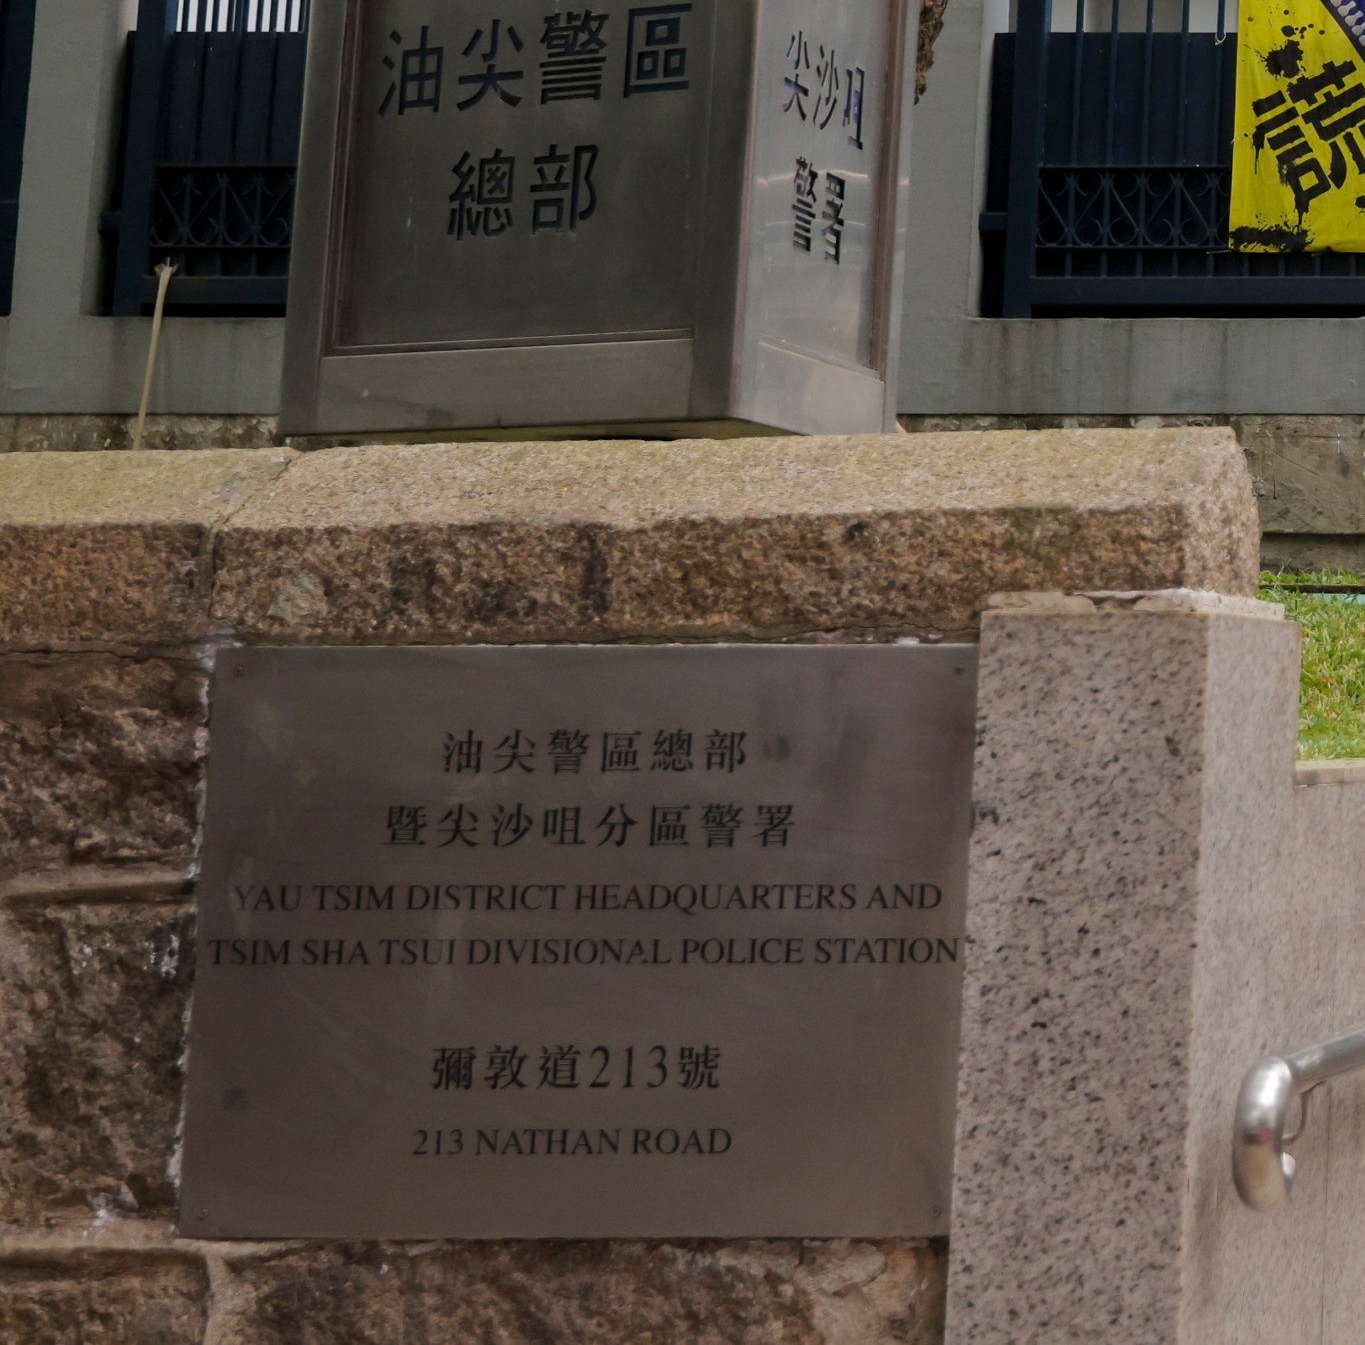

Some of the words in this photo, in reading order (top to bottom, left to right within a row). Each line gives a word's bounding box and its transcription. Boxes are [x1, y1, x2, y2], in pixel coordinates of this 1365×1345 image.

[376, 2, 694, 117] 油尖警區
[446, 143, 599, 242] 總部
[792, 156, 846, 265] 警署
[443, 729, 750, 774] 油尖警區總部
[384, 803, 796, 848] 暨尖沙咀分區警署
[233, 884, 303, 912] YAU
[313, 884, 396, 912] TSIM
[406, 884, 565, 912] DISTRICT
[575, 884, 857, 916] HEADQUARTERS
[866, 884, 943, 912] AND
[208, 938, 291, 966] TSIM
[302, 938, 369, 966] SHA
[379, 938, 457, 966] TSUI
[467, 938, 671, 966] DIVISIONAL
[680, 938, 804, 966] POLICE
[814, 938, 960, 966] STATION
[431, 1045, 722, 1091] 彌敦道213號
[412, 1128, 464, 1156] 213
[475, 1128, 622, 1156] NATHAN
[631, 1128, 733, 1156] ROAD
